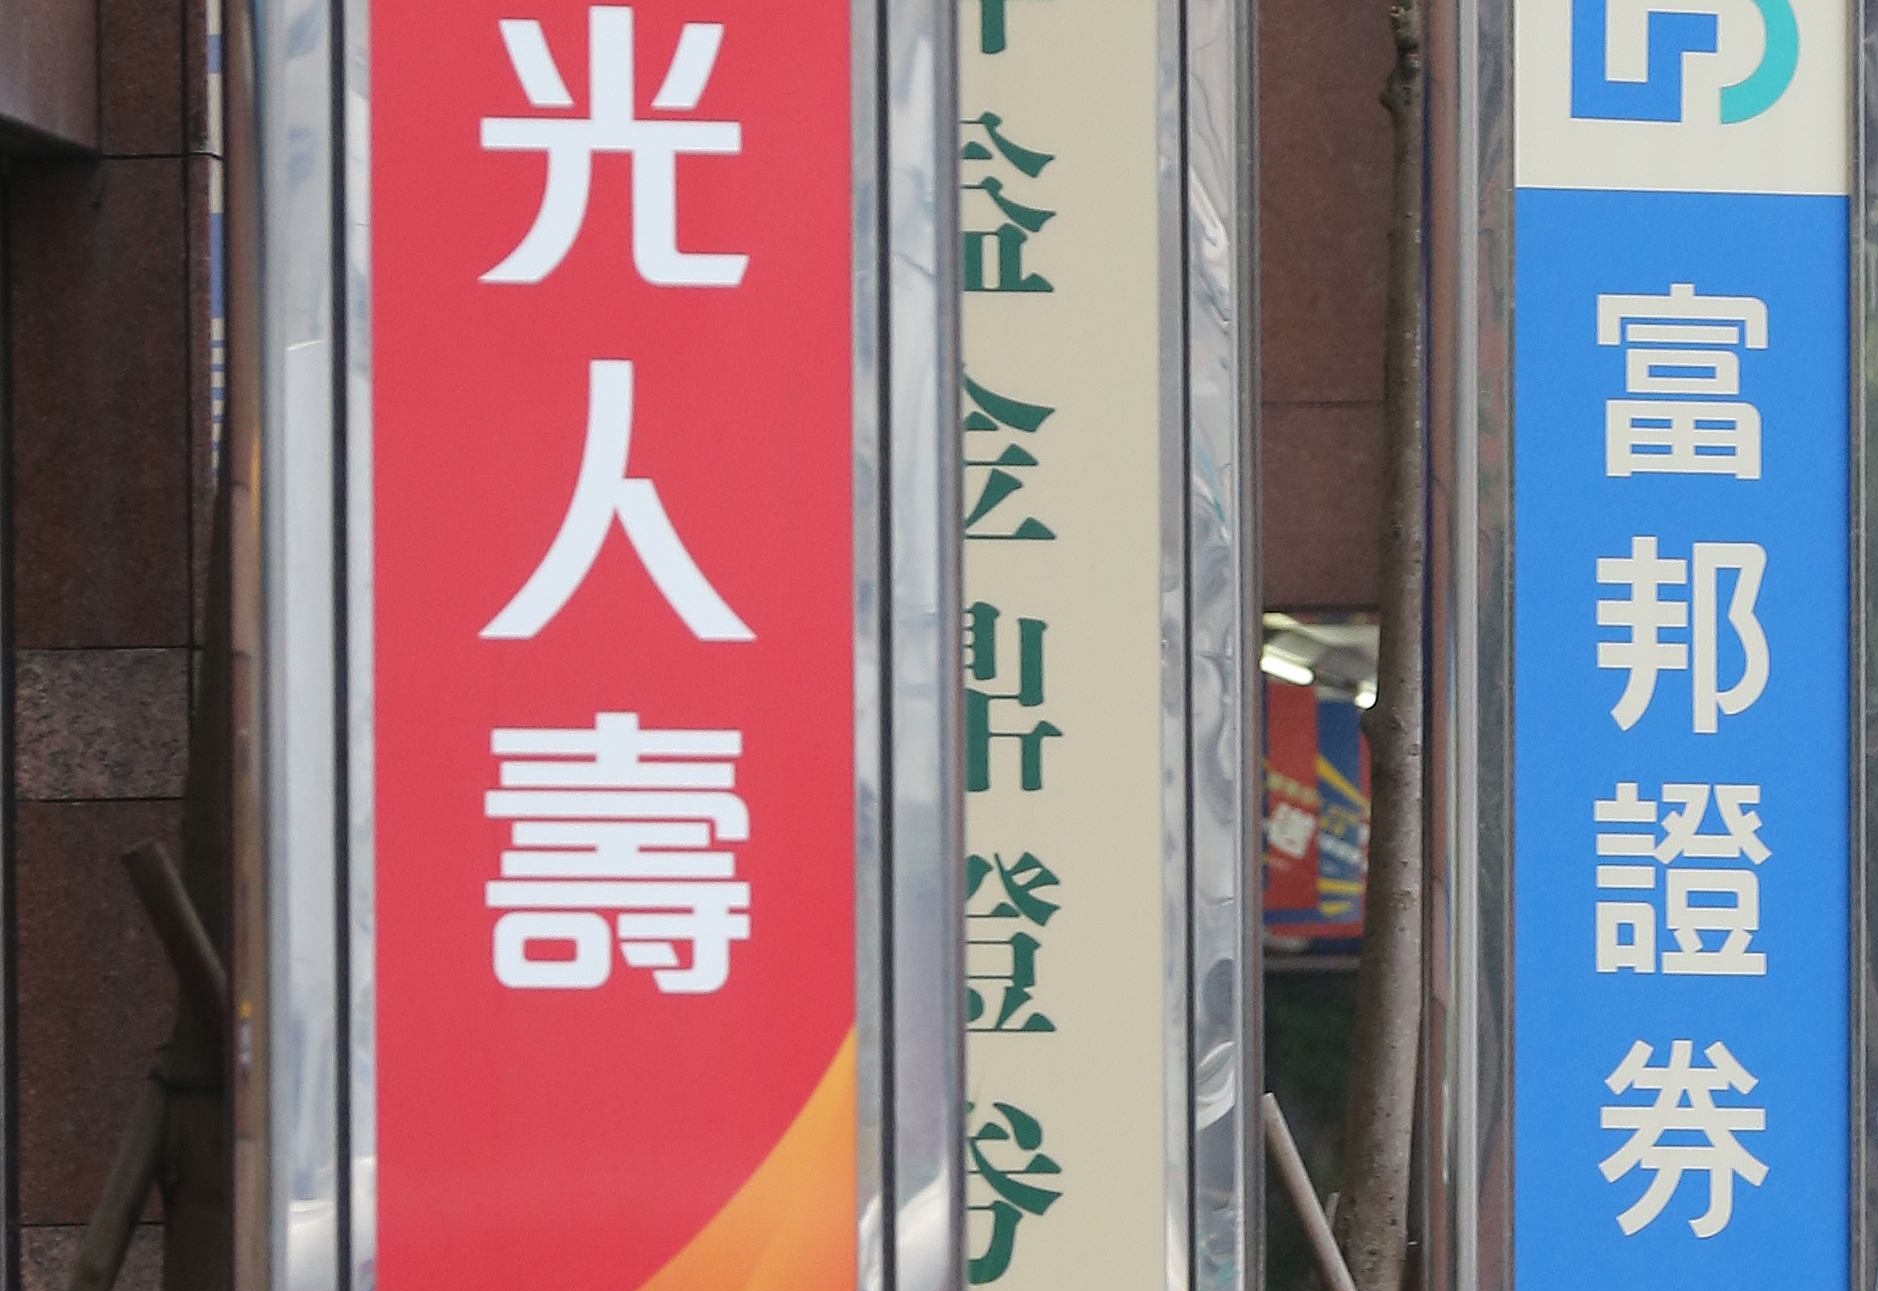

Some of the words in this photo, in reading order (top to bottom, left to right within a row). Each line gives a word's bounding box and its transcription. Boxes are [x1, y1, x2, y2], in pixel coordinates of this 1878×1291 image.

[479, 5, 757, 995] 光人壽
[1593, 281, 1772, 1238] 富邦證券
